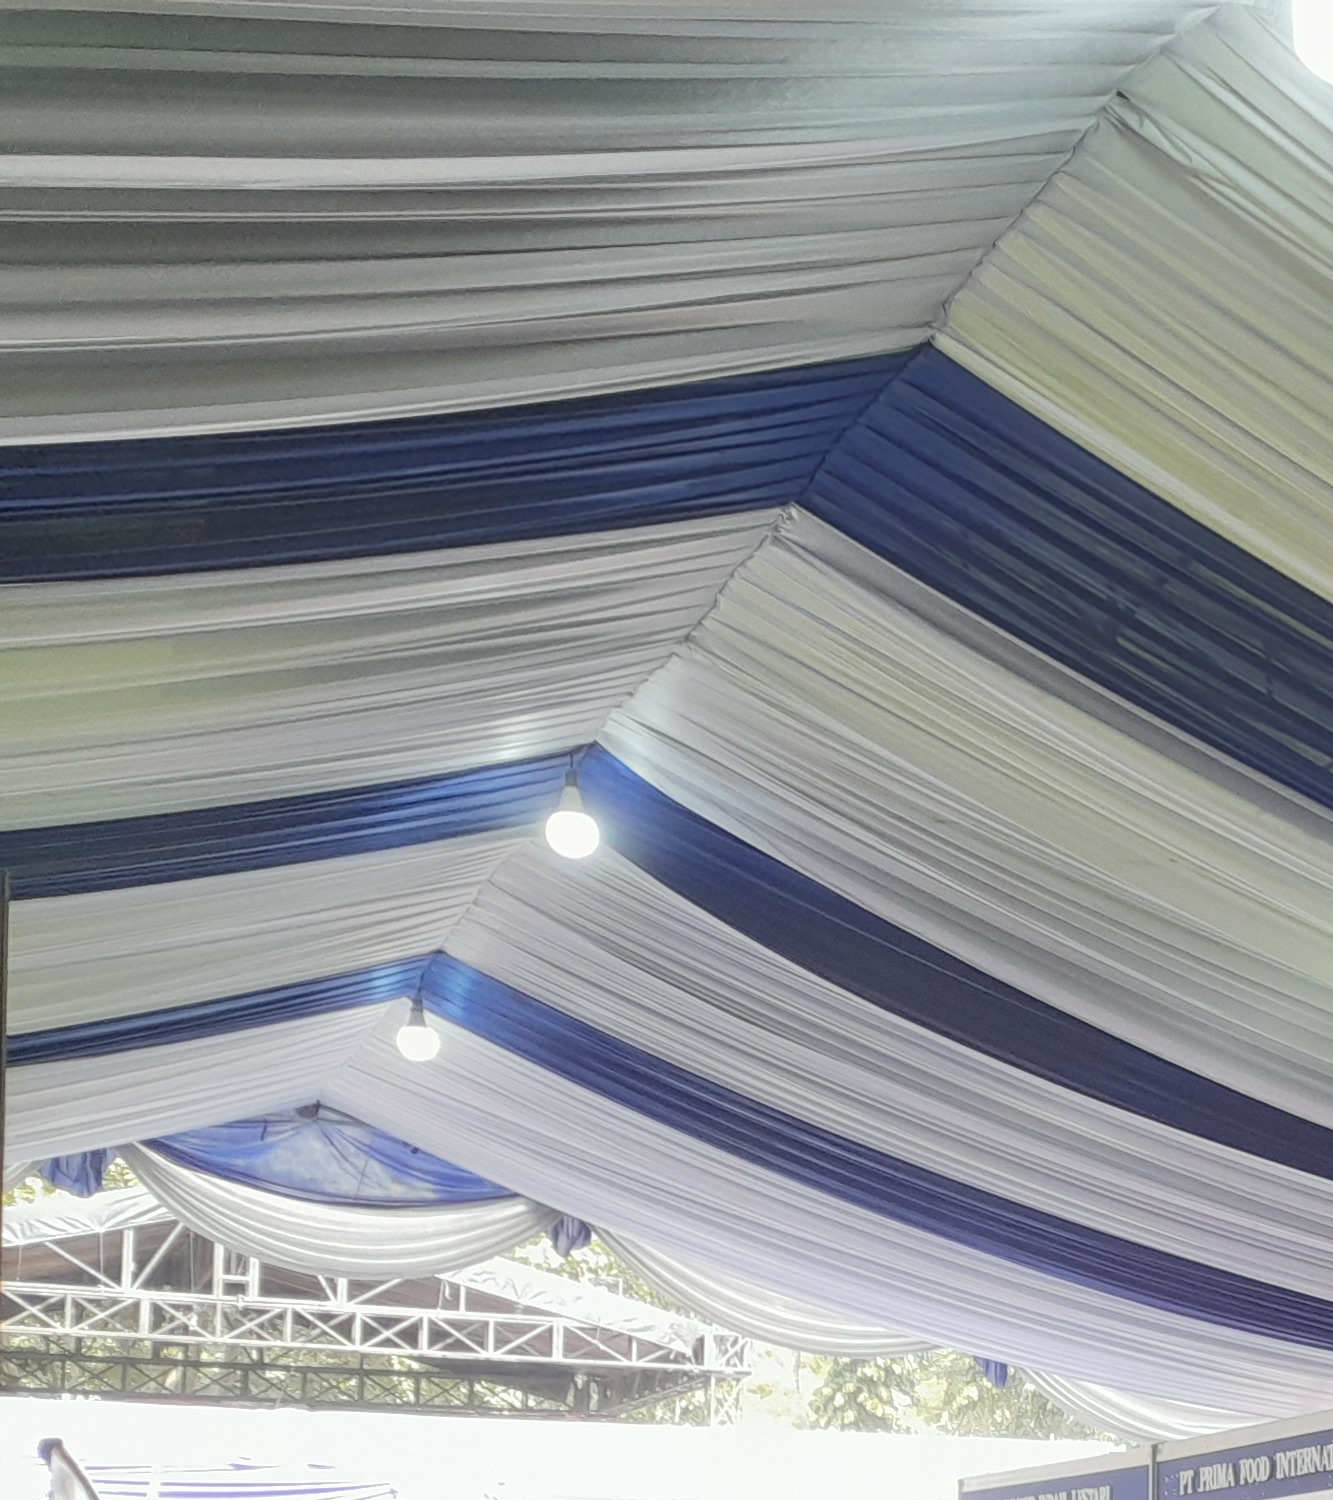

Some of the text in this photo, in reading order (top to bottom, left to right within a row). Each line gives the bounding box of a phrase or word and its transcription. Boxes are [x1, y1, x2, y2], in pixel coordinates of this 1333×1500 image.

[1179, 1469, 1195, 1495] PT
[1197, 1462, 1235, 1492] PRIMA
[1238, 1456, 1270, 1486] FOOD
